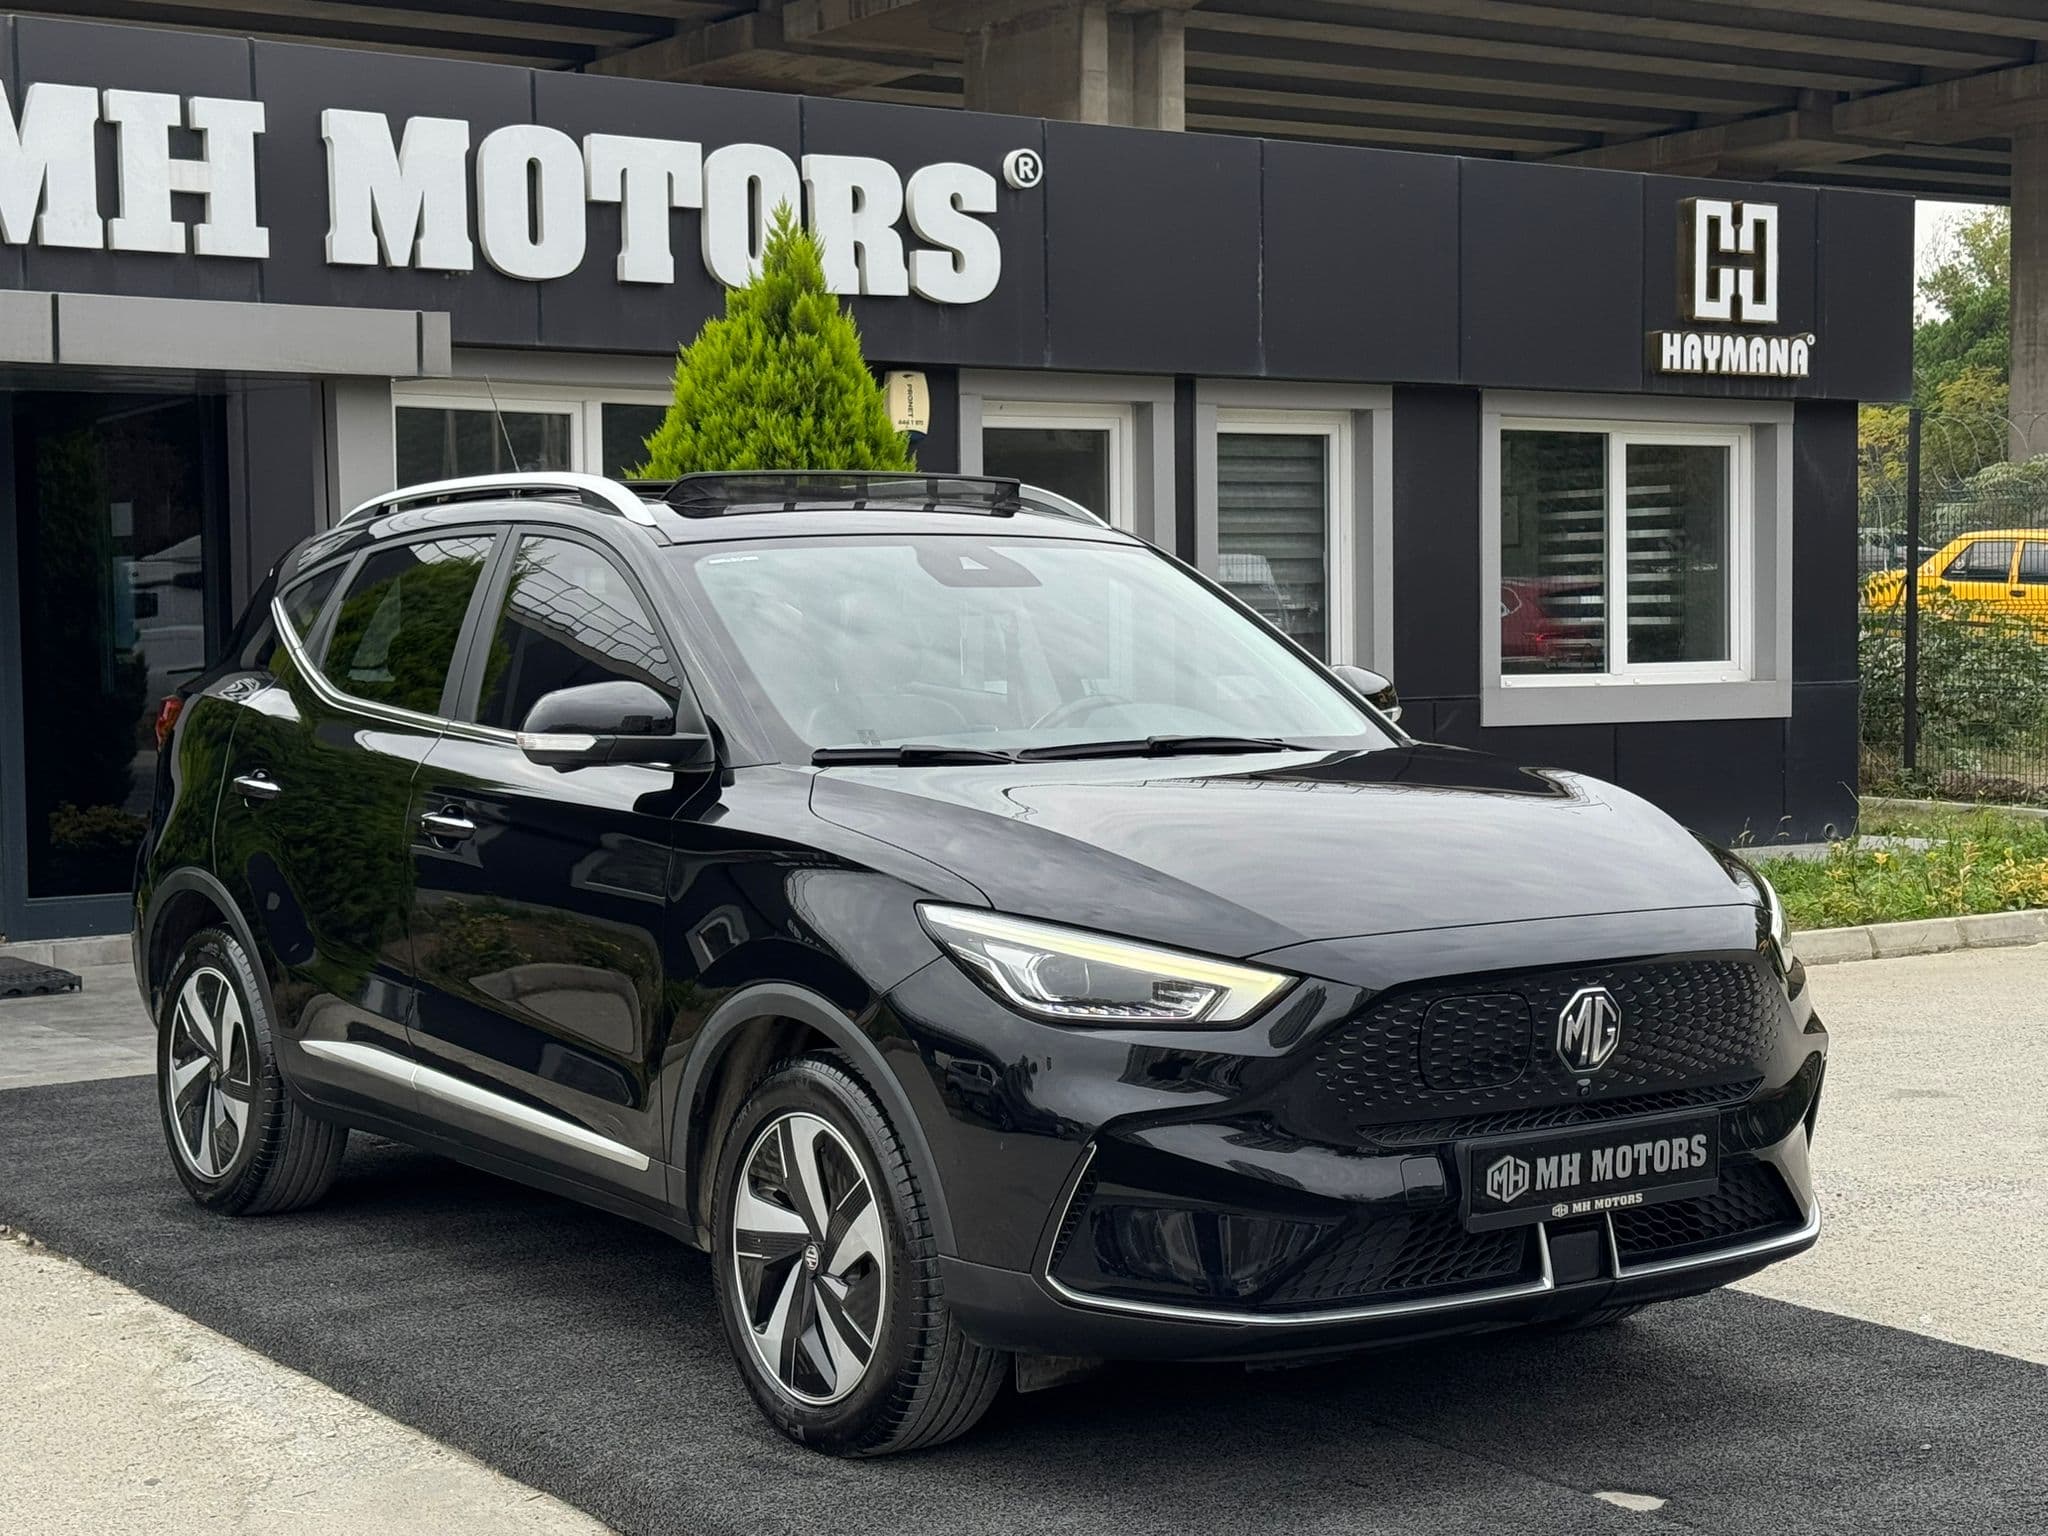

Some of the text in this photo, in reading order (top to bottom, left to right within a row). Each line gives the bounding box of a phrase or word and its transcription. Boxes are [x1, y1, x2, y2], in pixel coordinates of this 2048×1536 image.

[0, 79, 270, 258] MH
[321, 108, 1001, 304] MOTORS
[1661, 332, 1809, 376] HAYMANA
[1563, 995, 1617, 1066] MG
[1535, 1134, 1707, 1191] MH MOTORS
[1572, 1193, 1643, 1213] MH MOTORS
